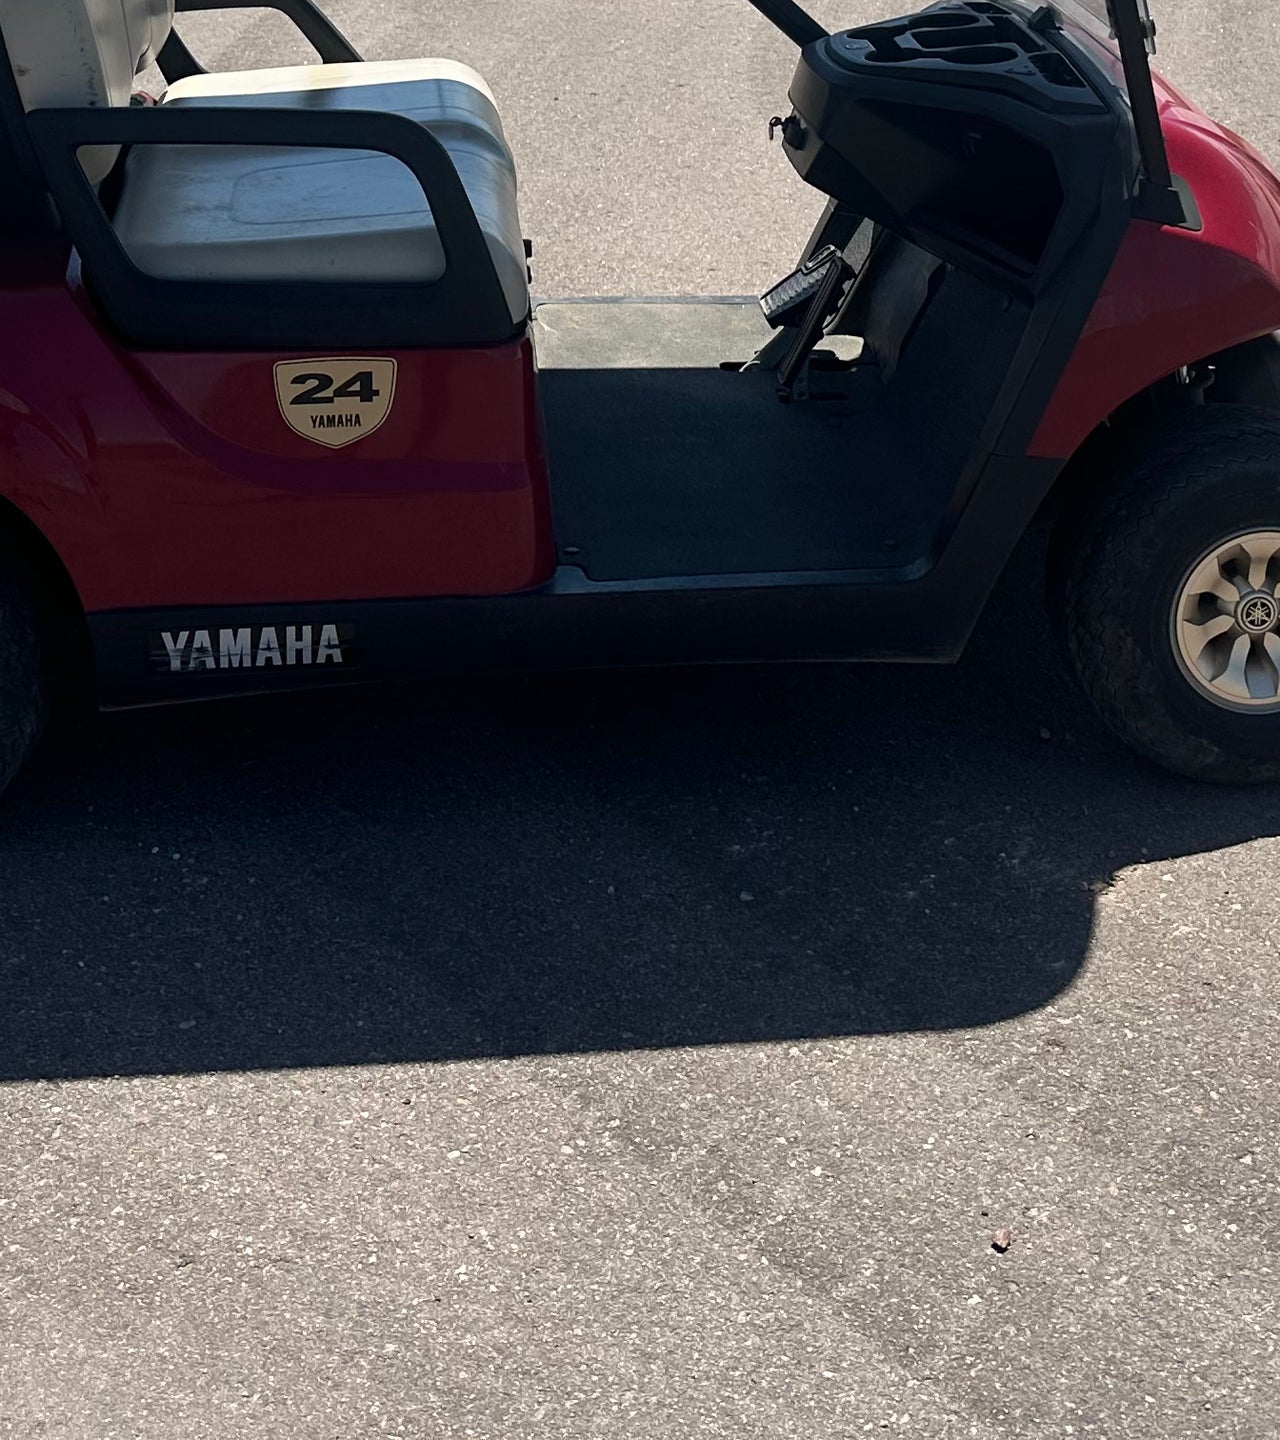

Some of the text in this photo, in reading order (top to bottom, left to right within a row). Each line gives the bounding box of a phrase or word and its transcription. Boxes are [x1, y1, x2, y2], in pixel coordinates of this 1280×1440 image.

[289, 371, 380, 405] 24
[310, 413, 361, 429] YAMAHA
[160, 624, 344, 671] YAMAHA
